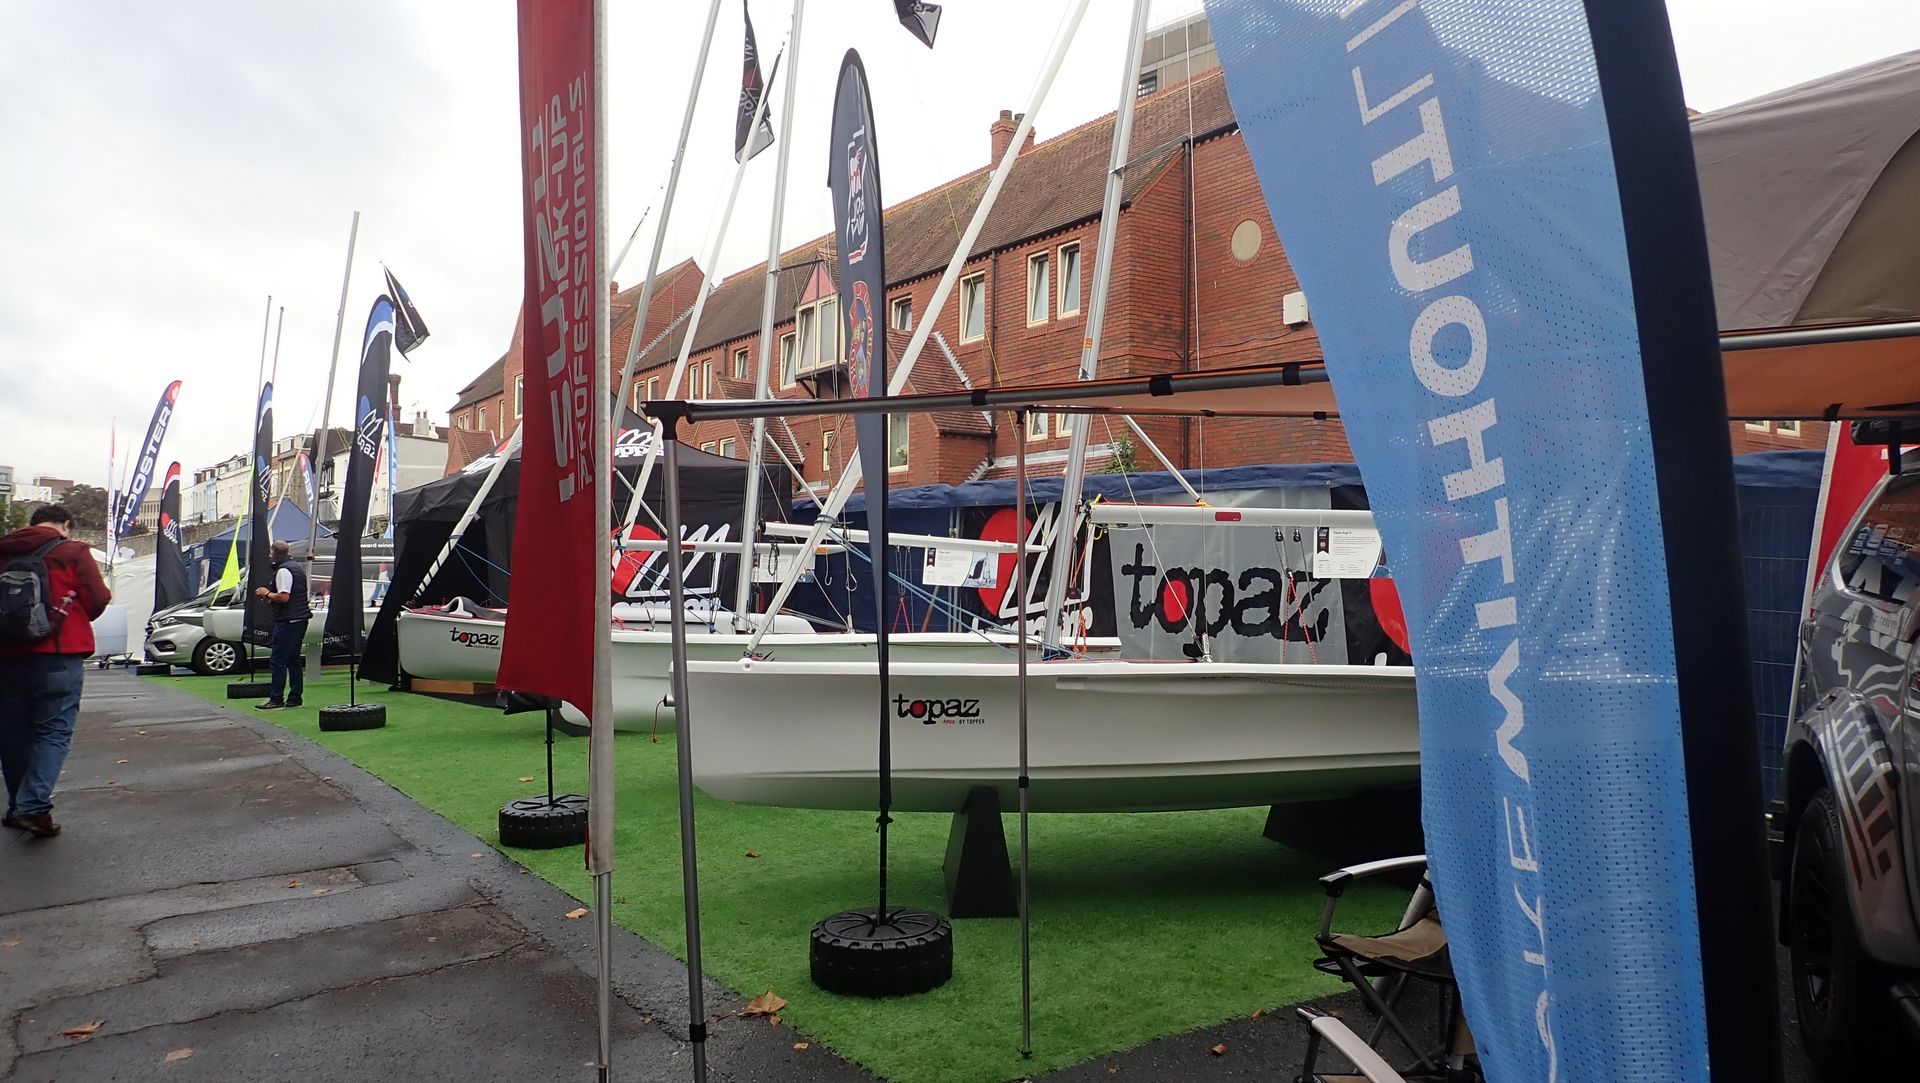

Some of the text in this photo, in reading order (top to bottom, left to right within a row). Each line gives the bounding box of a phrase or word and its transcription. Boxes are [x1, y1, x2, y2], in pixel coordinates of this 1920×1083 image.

[549, 94, 571, 335] PICK-UP
[568, 76, 592, 490] PROFESSIONALS
[532, 115, 576, 503] ISUZU
[449, 627, 500, 648] topaz
[1121, 542, 1332, 659] topaz
[892, 693, 980, 725] topaz
